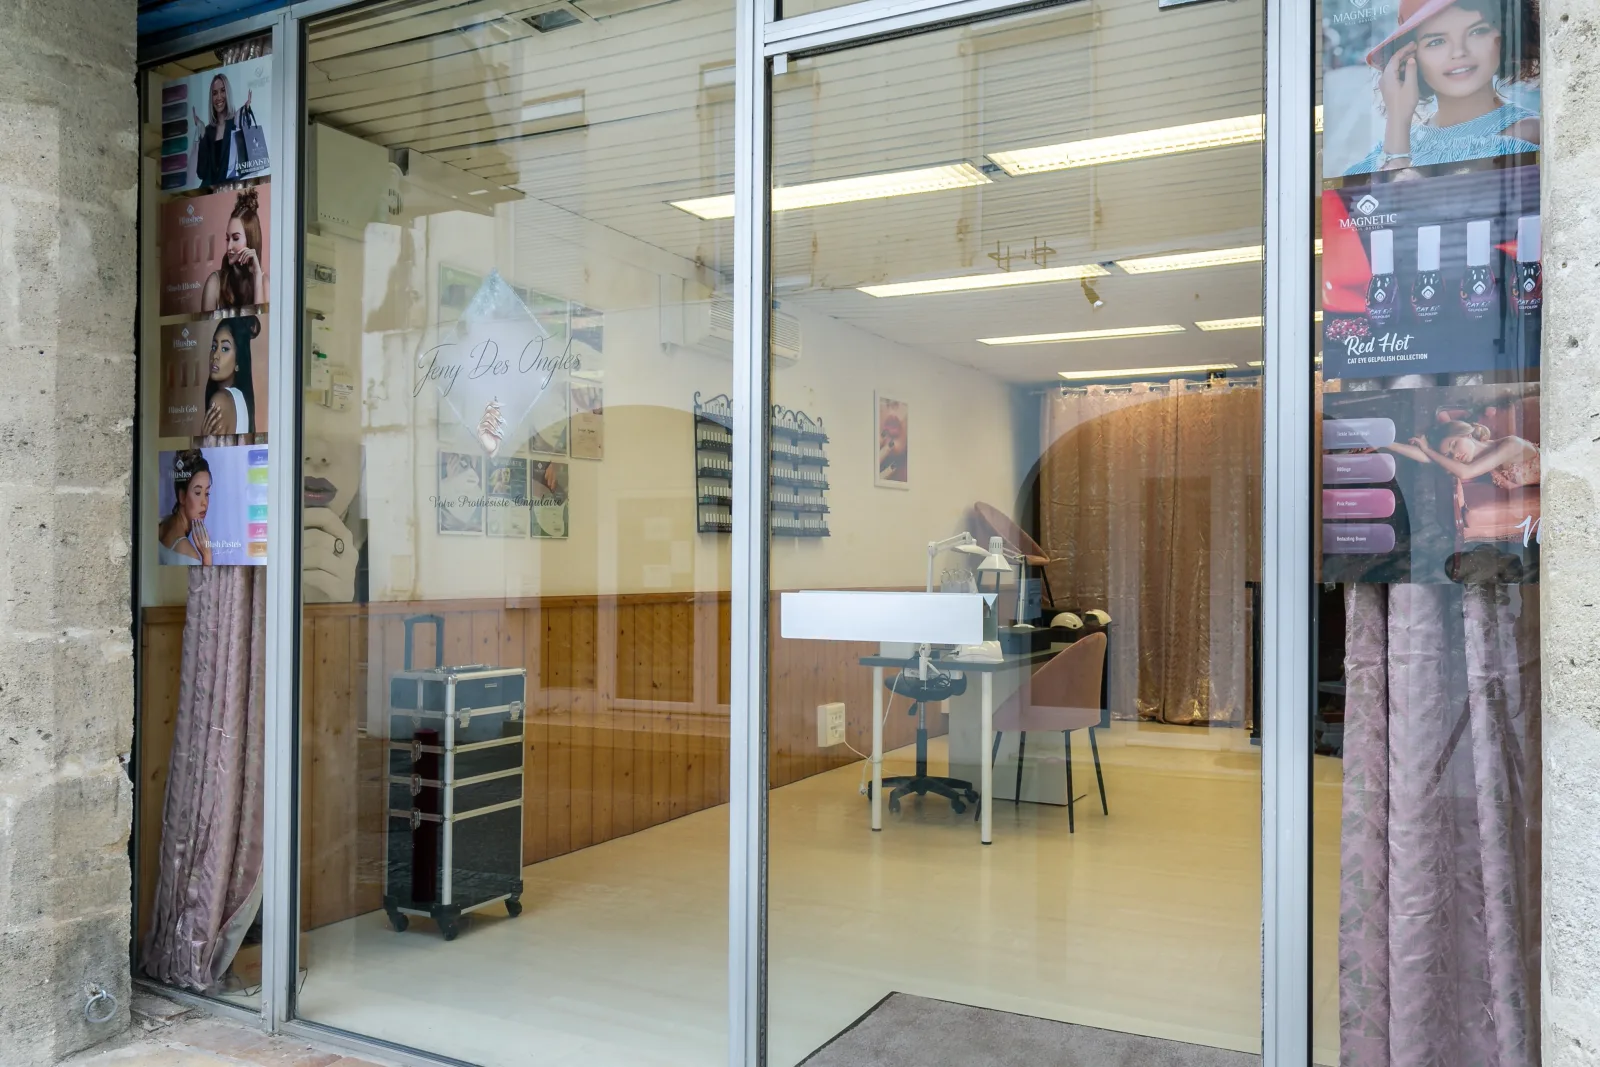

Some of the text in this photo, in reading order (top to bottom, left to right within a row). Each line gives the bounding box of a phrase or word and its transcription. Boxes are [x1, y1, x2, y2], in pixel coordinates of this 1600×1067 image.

[1332, 4, 1390, 23] MAGNETIC
[1338, 213, 1398, 229] MAGNETIC
[1344, 332, 1415, 356] Red Hot
[468, 338, 510, 380] Des
[518, 332, 582, 390] Ongles
[1367, 355, 1396, 363] GELPOLISH
[1396, 353, 1428, 361] COLLECTION
[428, 495, 455, 508] Votre
